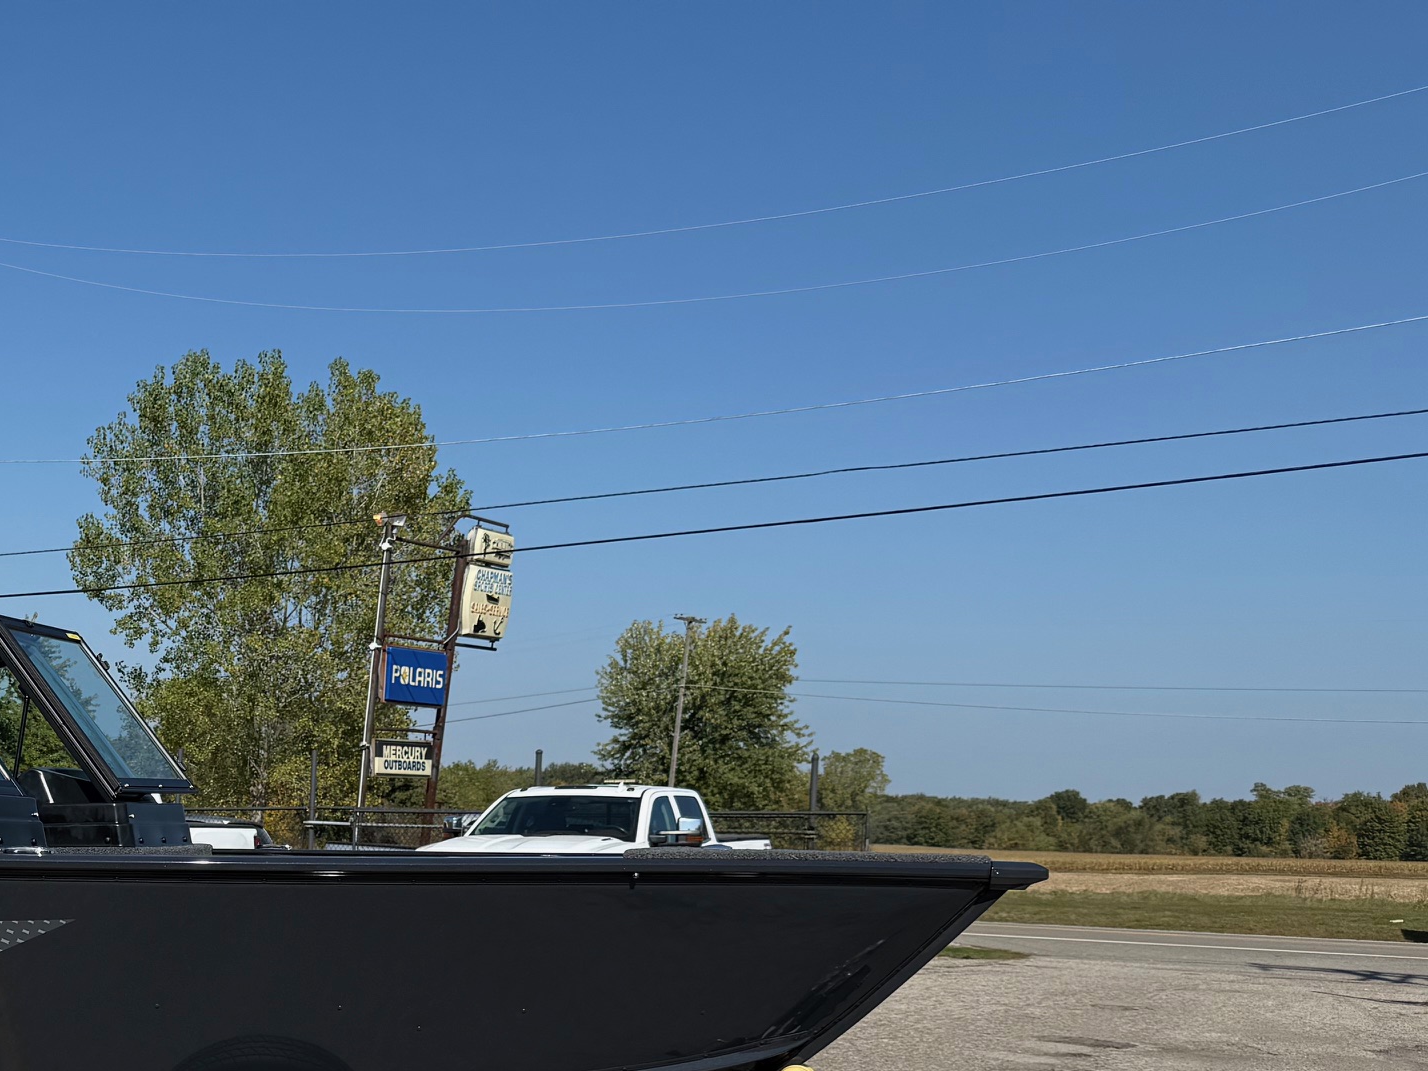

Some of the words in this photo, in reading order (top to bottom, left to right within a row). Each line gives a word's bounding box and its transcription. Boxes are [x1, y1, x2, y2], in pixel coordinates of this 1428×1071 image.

[392, 665, 443, 688] POLARIS
[383, 745, 427, 760] MERCURY
[384, 760, 426, 771] OUTBOARDS
